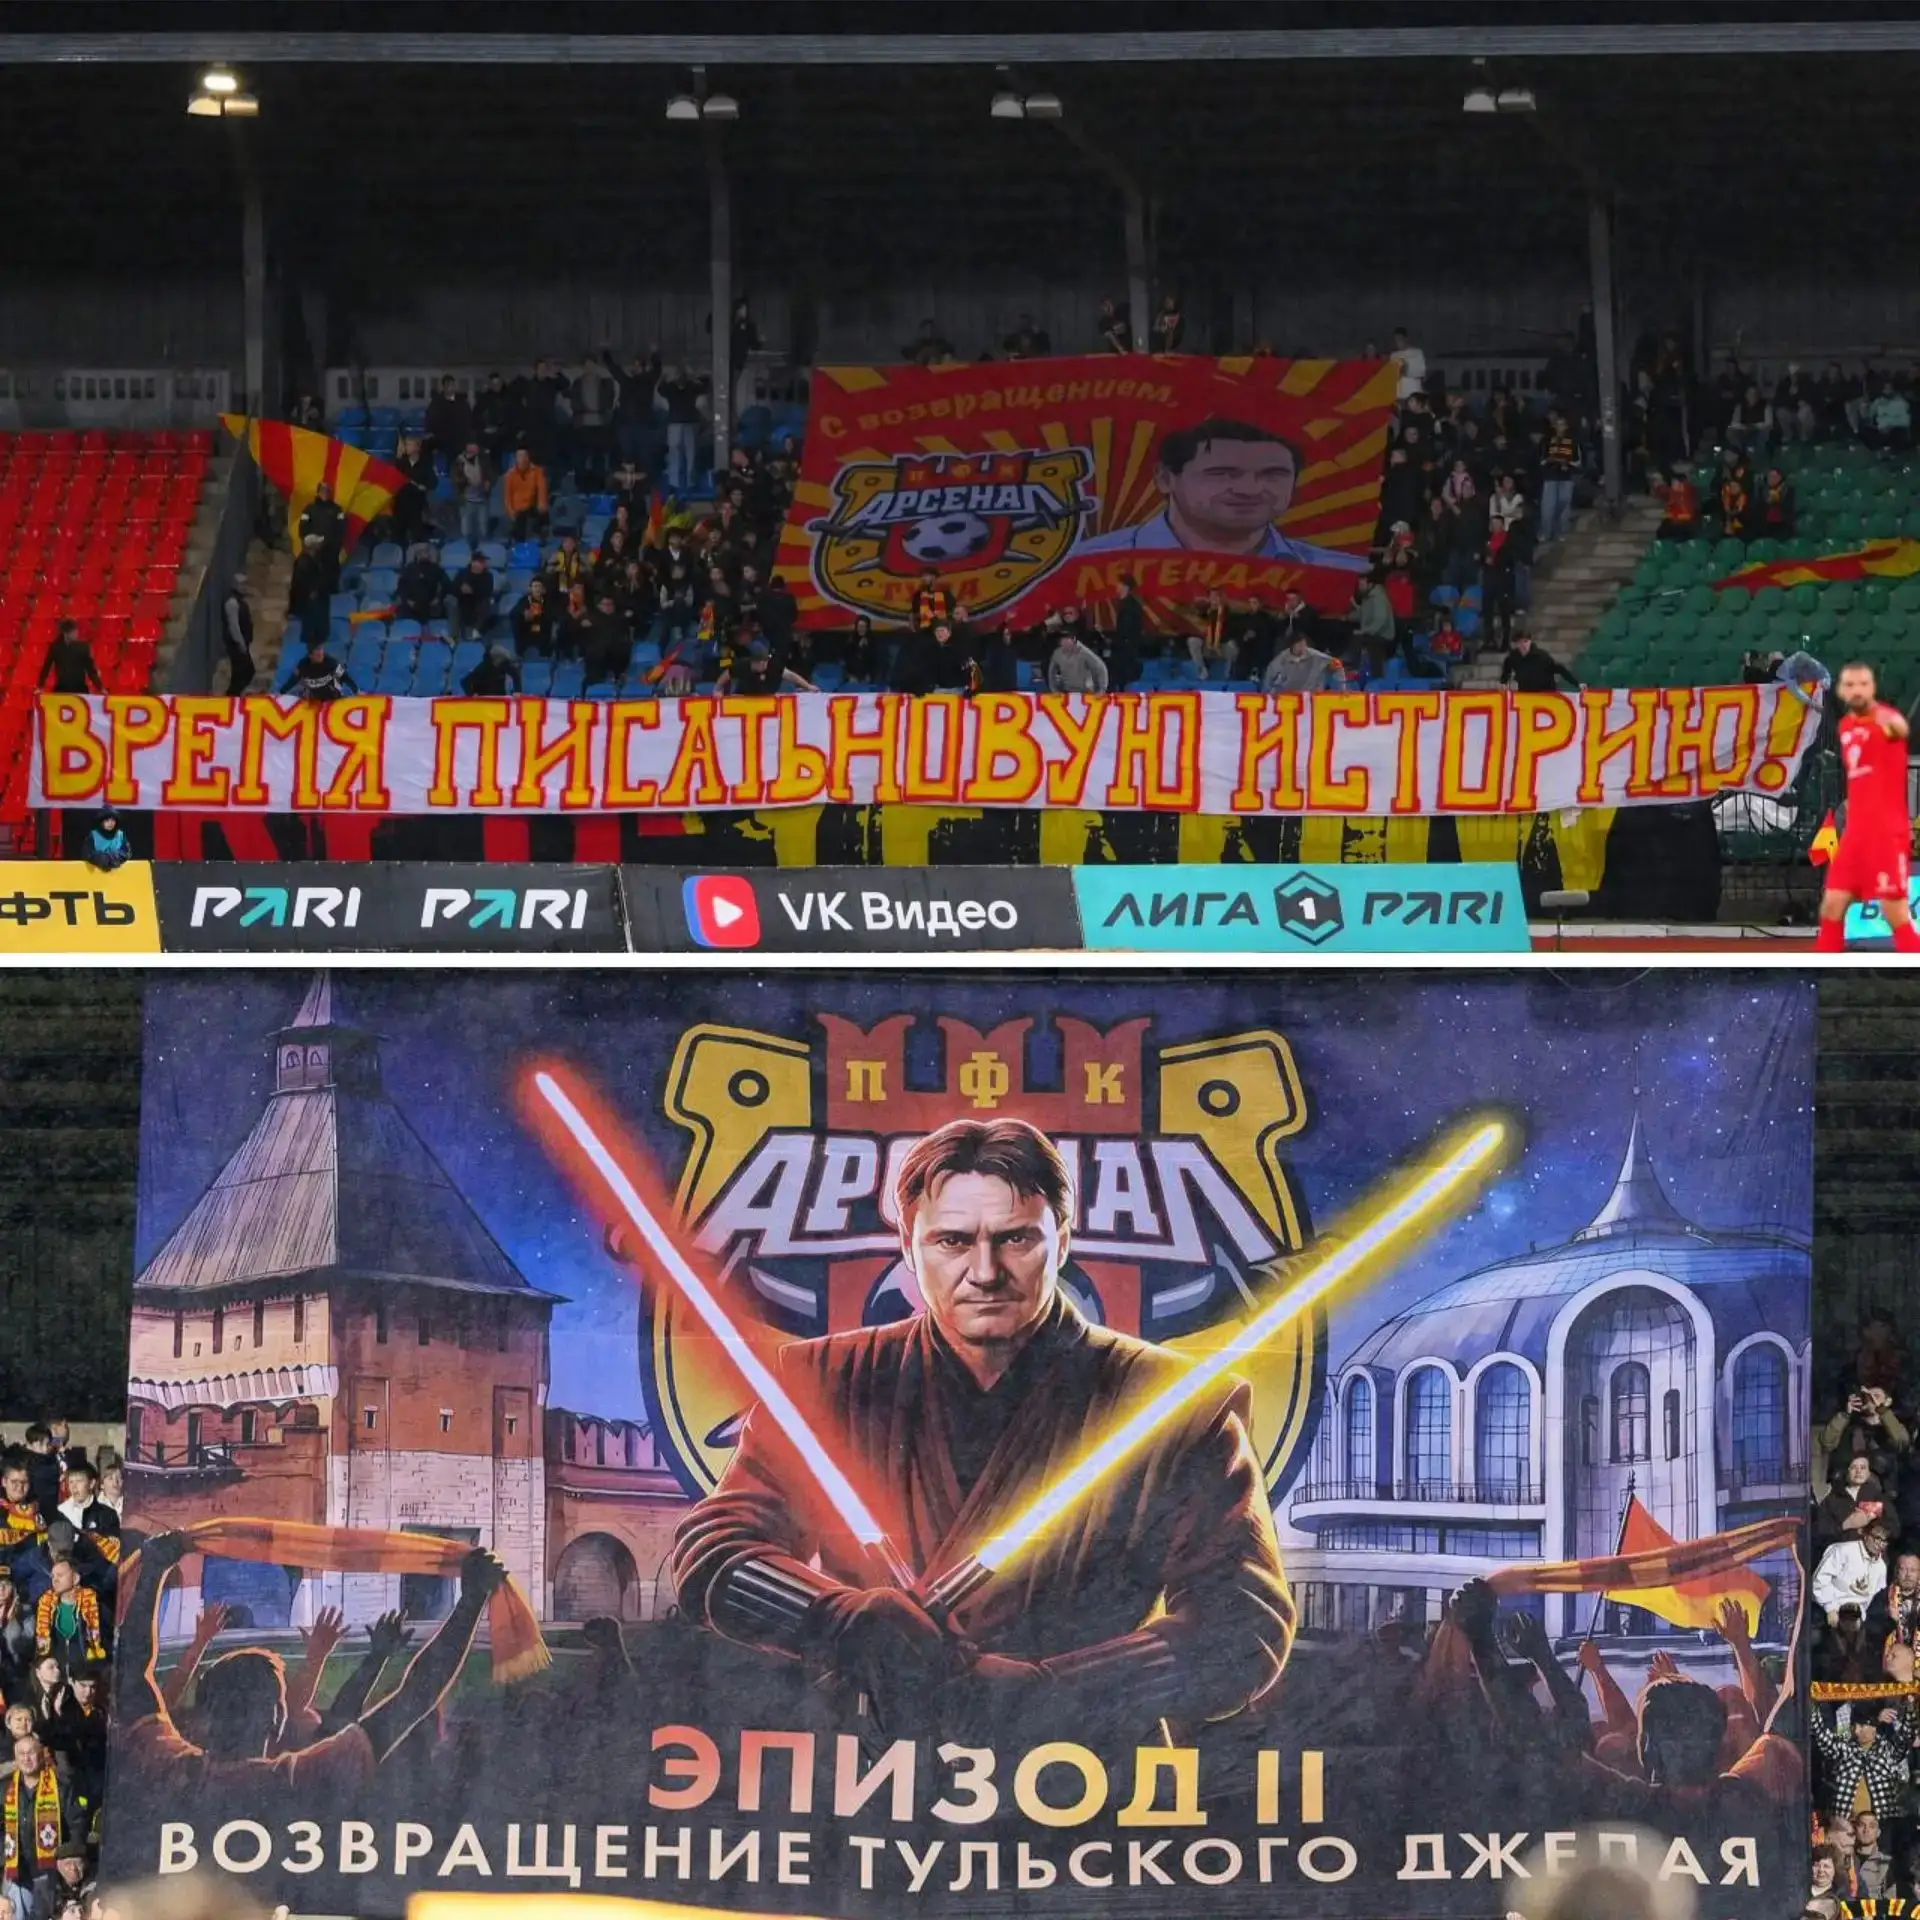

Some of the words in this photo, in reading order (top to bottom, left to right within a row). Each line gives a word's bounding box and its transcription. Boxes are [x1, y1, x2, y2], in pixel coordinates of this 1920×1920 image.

[819, 415, 847, 438] С
[856, 483, 1064, 524] АРСЕНАЛ
[35, 692, 394, 810] ВРЕМЯ
[425, 694, 828, 810] ПИСАТЬ
[826, 690, 1202, 812] НОВУЮ
[1230, 681, 1822, 814] ИСТОРИЮ!
[189, 885, 362, 928] PARI
[419, 887, 589, 930] PARI
[778, 891, 854, 931] VK
[861, 890, 1019, 939] Видео
[1101, 891, 1261, 927] ЛИГА
[1361, 890, 1504, 925] PARI
[647, 1725, 1207, 1827] ЭПИЗОД
[1256, 1749, 1325, 1824] II
[158, 1818, 812, 1887] ВОЗВРАЩЕНИЕ
[849, 1832, 1359, 1892] ТУЛЬСКОГО
